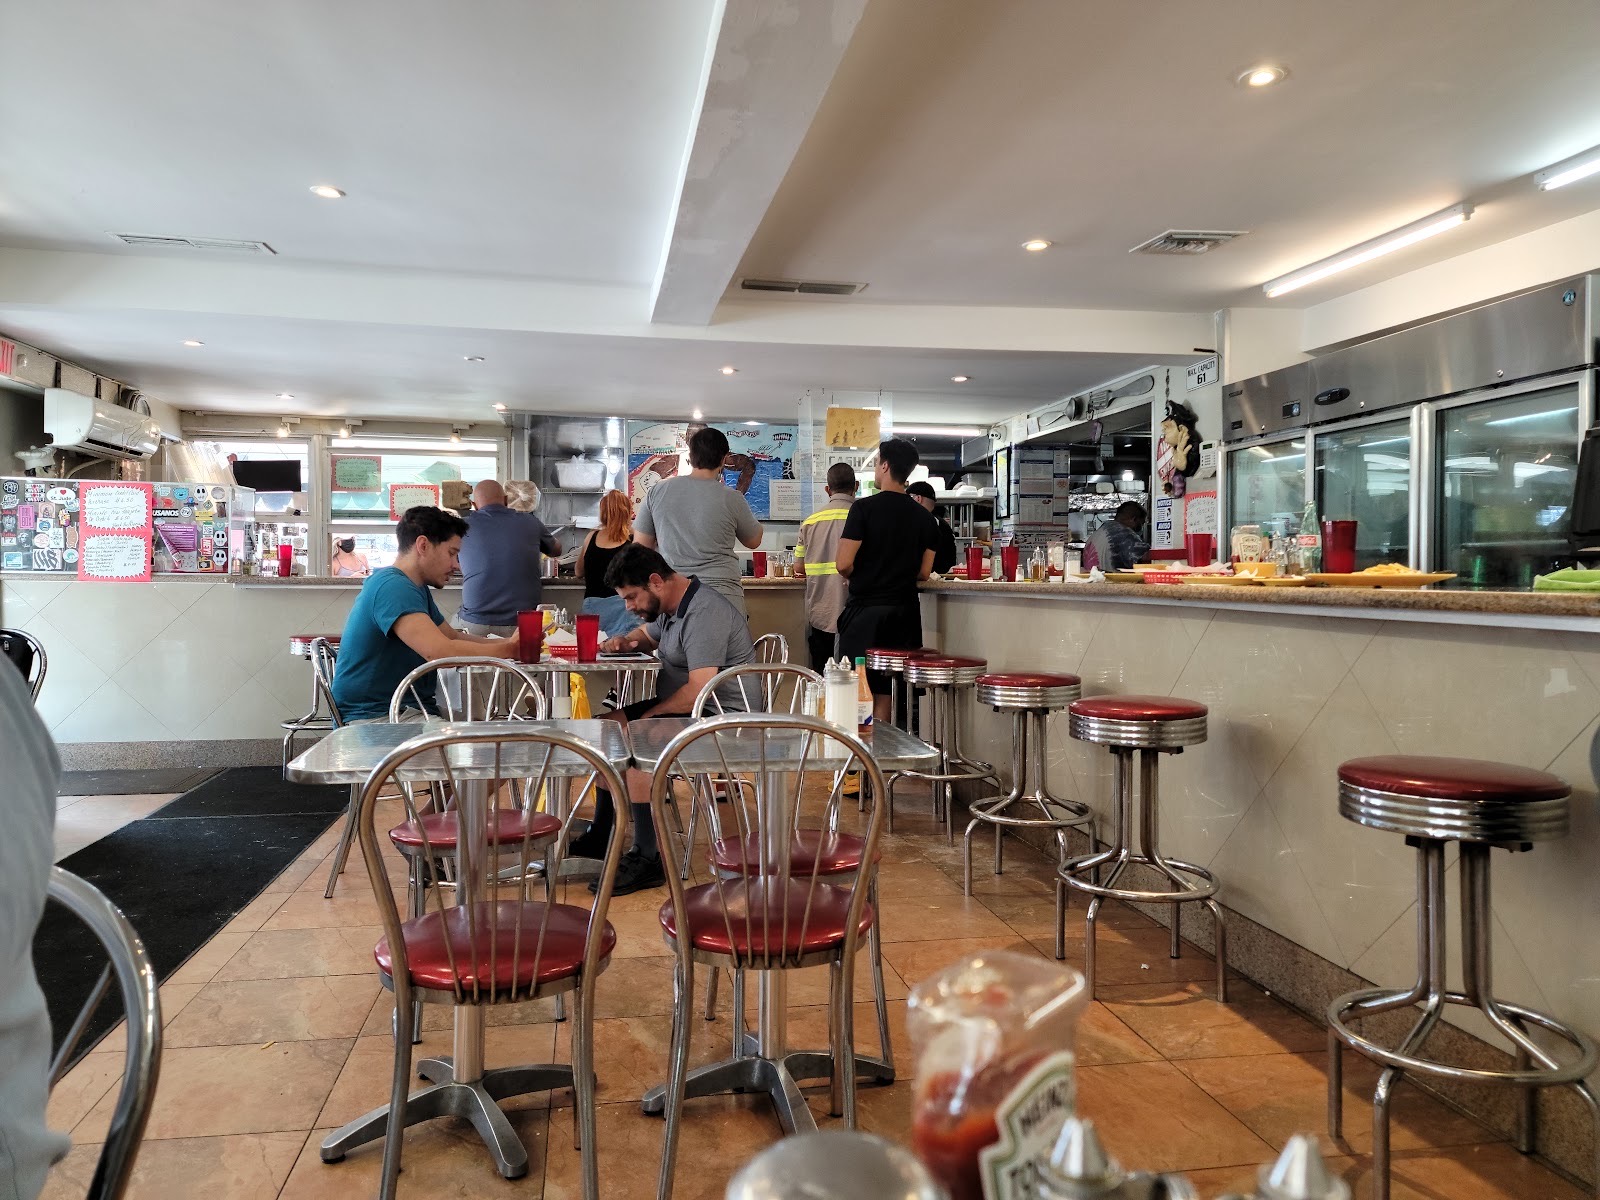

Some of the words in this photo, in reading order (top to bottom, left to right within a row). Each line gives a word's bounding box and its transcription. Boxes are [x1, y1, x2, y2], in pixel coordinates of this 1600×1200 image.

[0, 340, 15, 375] XIT
[1197, 360, 1215, 373] CAPACITY
[1197, 372, 1206, 384] 61
[1157, 499, 1172, 507] NOTICE
